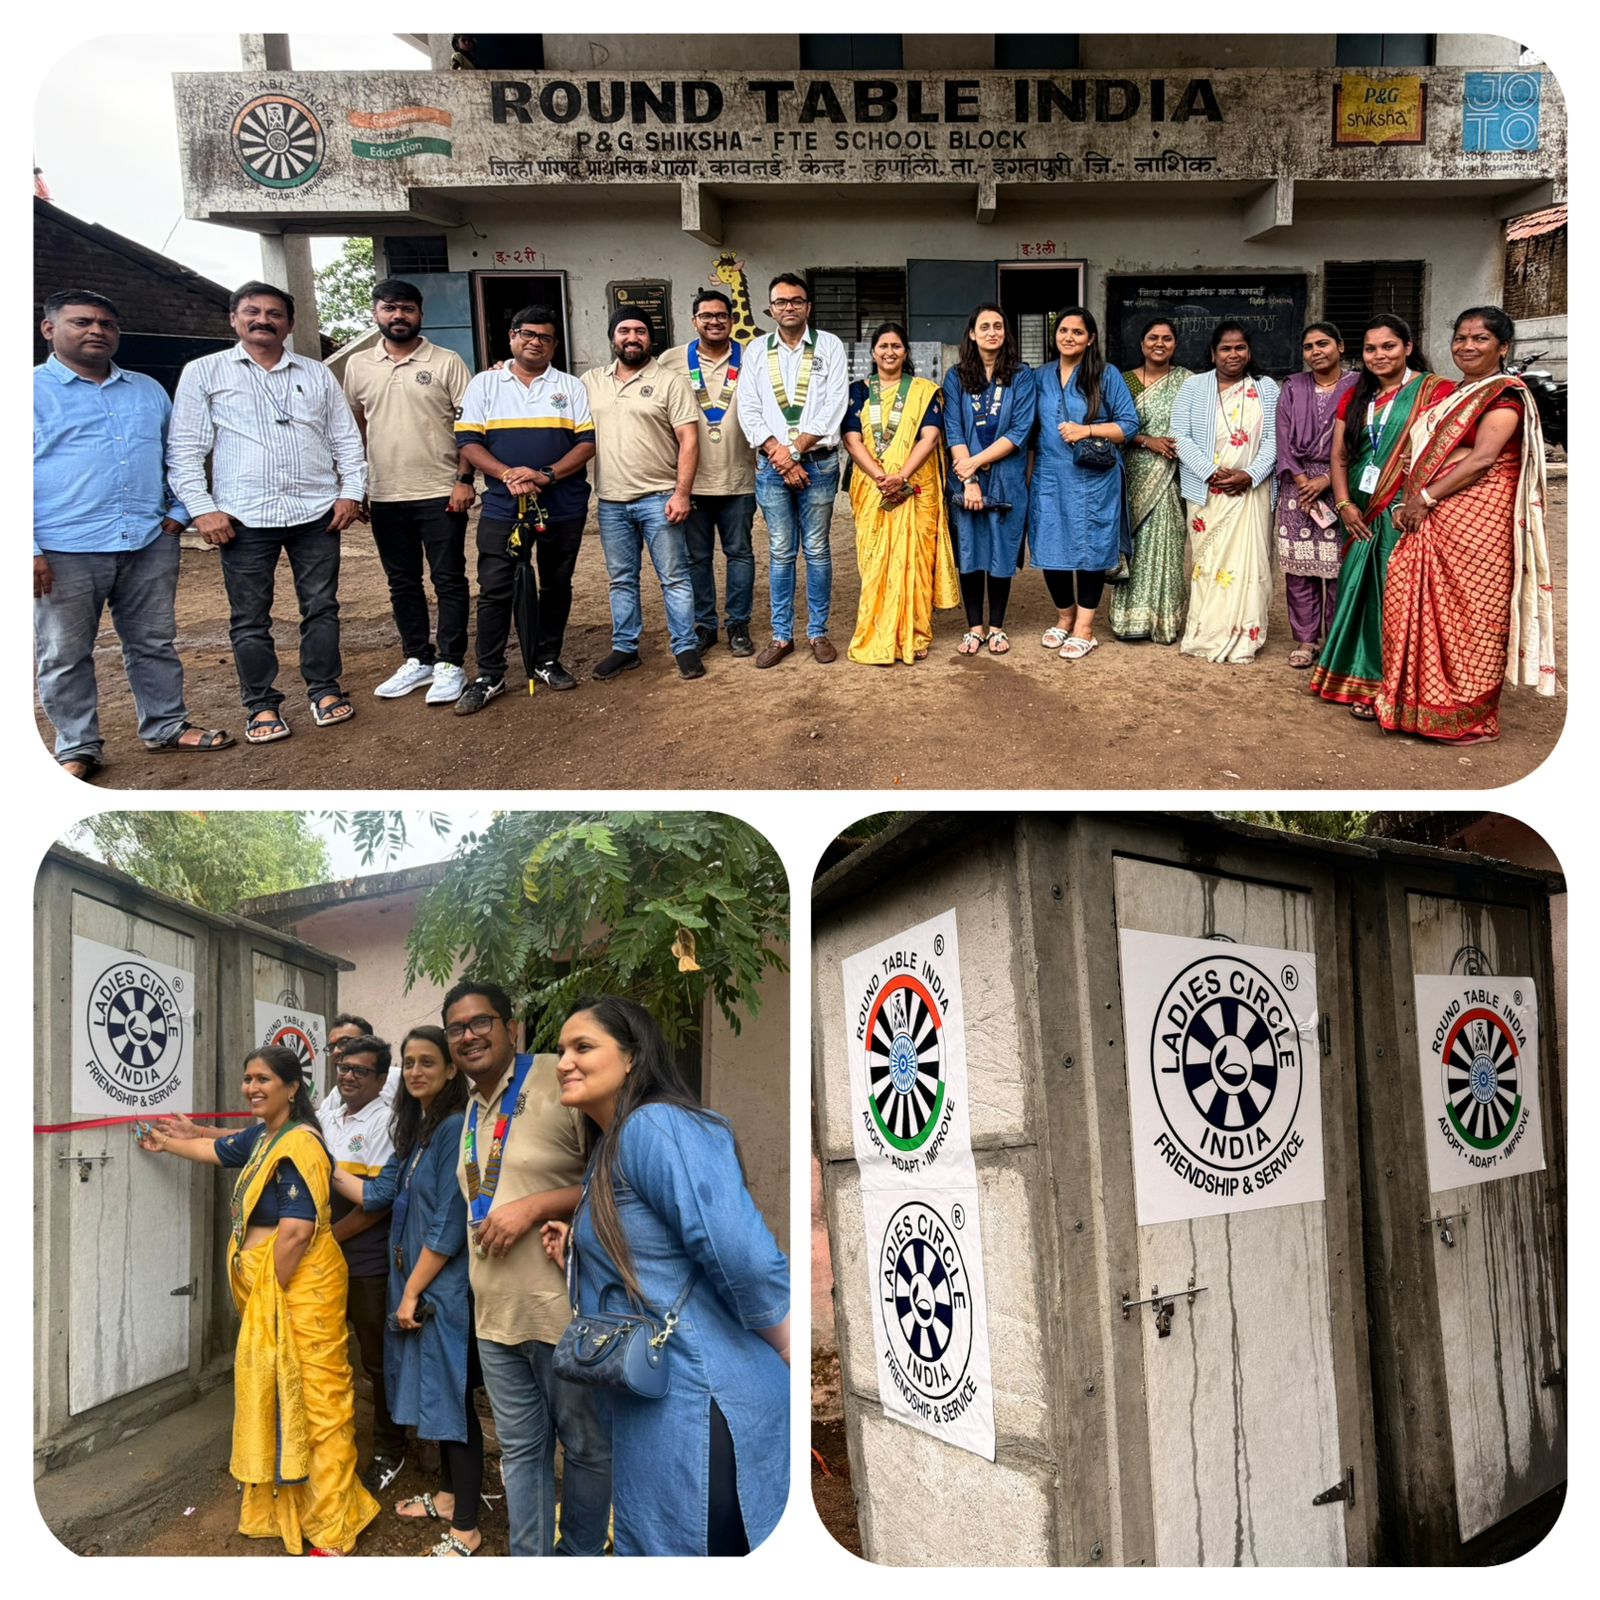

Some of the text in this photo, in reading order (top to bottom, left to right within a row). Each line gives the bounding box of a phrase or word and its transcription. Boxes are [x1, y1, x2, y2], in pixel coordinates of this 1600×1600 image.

[218, 79, 333, 130] ROUND TABLE INDIA
[491, 78, 1223, 124] ROUND TABLE INDIA
[1363, 87, 1400, 103] P&G
[577, 131, 634, 152] P&G
[645, 130, 743, 151] SHIKSHA
[774, 131, 818, 150] FTE
[835, 130, 935, 150] SCHOOL
[950, 130, 1028, 150] BLOCK
[1347, 110, 1408, 128] shiksha
[370, 141, 422, 157] Education
[265, 192, 295, 200] ADAPT
[94, 969, 178, 1038] LADIES CIRCLE
[856, 950, 949, 1040] ROUND TABLE INDIA
[284, 1016, 304, 1029] TABLE
[306, 1028, 318, 1054] INDIA
[1161, 970, 1296, 1074] LADIES CIRCLE
[1432, 989, 1526, 1054] ROUND TABLE INDIA
[86, 1060, 182, 1107] FRIENDSHIP & SERVICE
[115, 1062, 160, 1085] INDIA
[862, 1098, 956, 1173] ADOPT ADAPT IMPROVE
[1200, 1126, 1271, 1160] INDIA
[1438, 1107, 1530, 1168] ADOPT ADAPT IMPROVE
[1154, 1130, 1304, 1197] FRIENDSHIP & SERVICE
[884, 1214, 966, 1310] LADIES CIRCLE
[884, 1350, 978, 1423] FRIENDSHIP & SERVICE
[907, 1352, 952, 1388] INDIA
